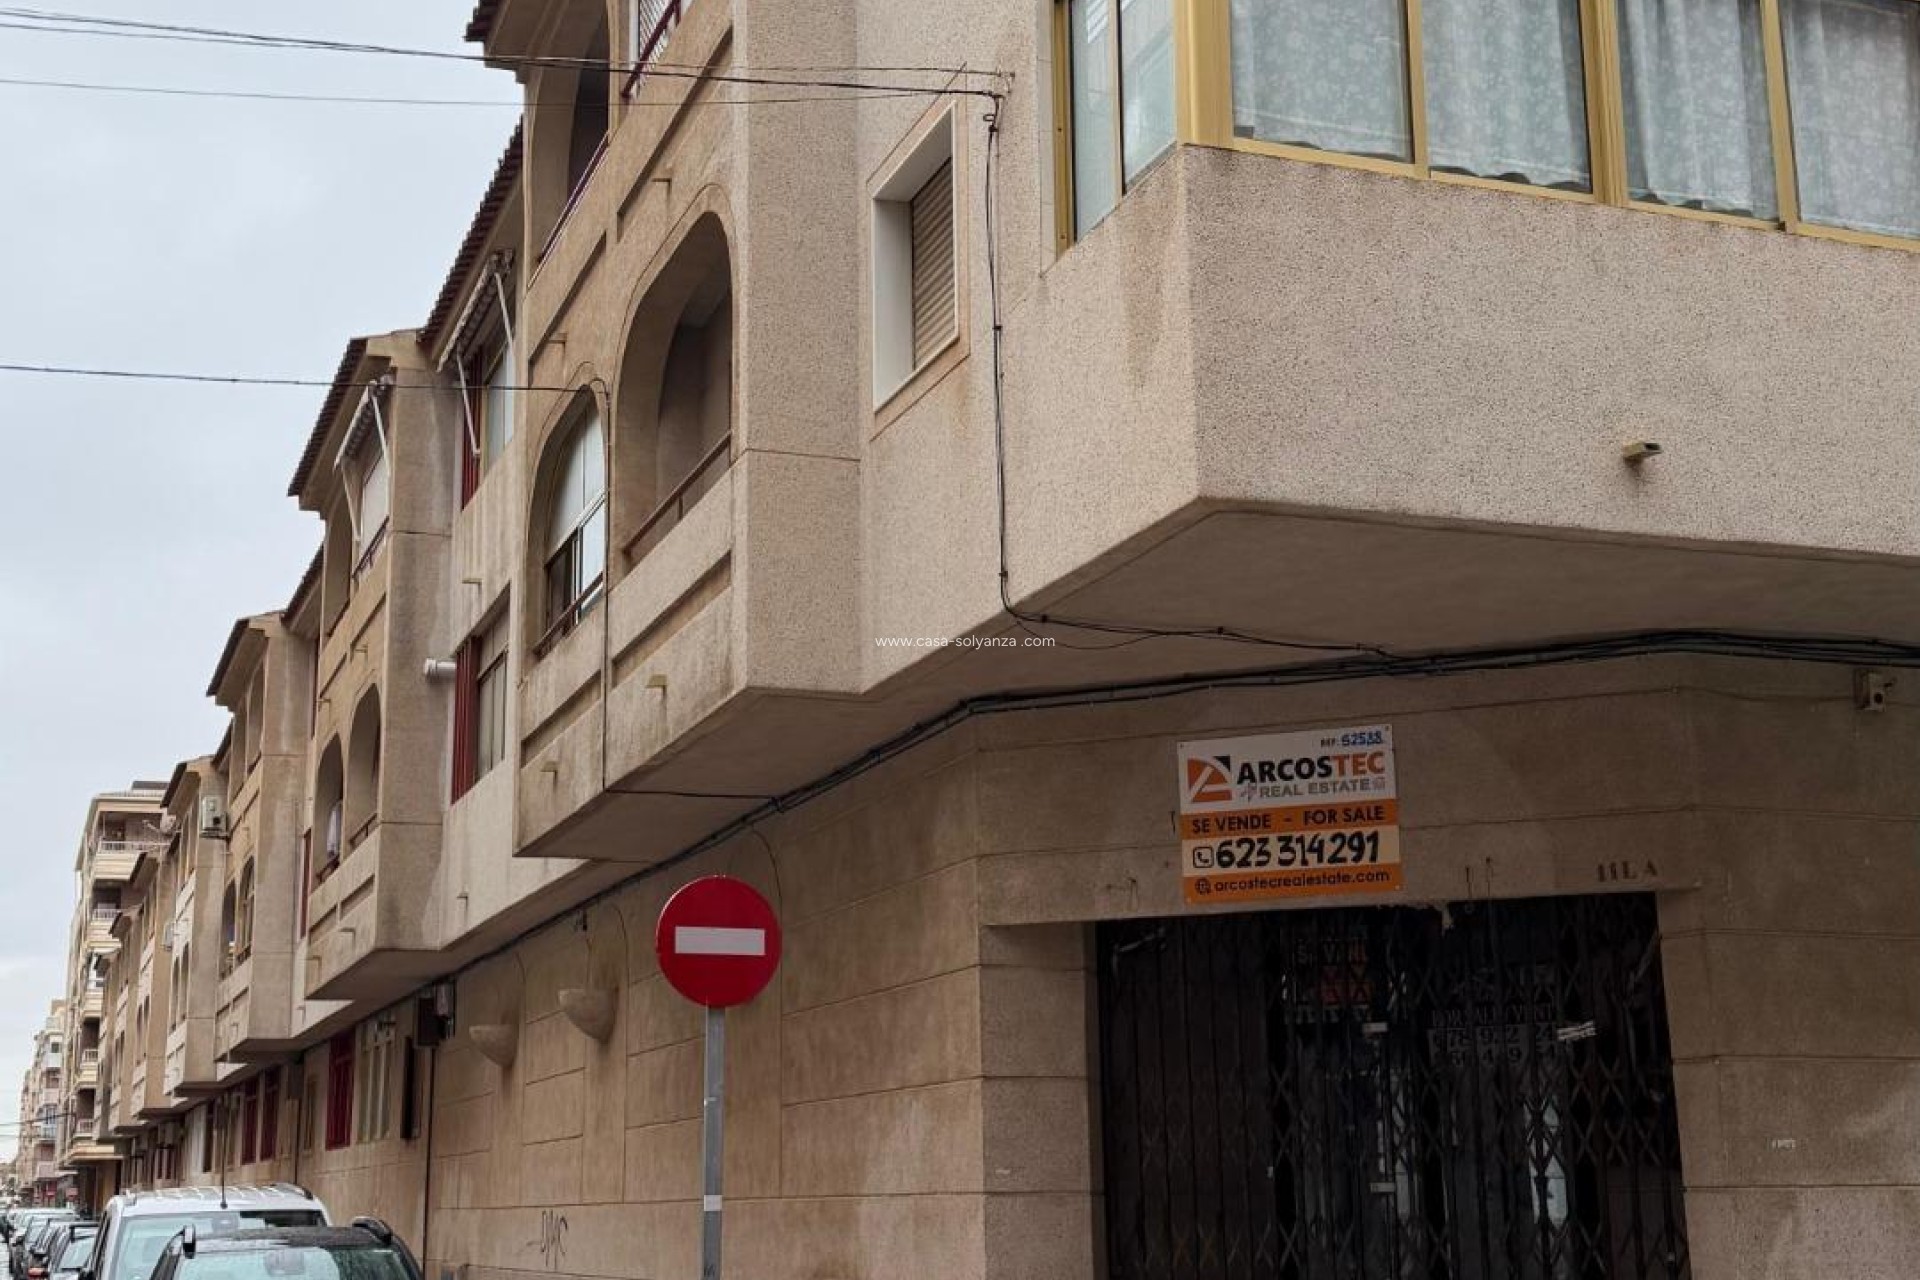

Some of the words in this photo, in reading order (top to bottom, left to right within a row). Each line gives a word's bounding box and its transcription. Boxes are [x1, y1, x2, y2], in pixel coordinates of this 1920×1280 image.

[1237, 751, 1385, 785] ARCOSTEC
[1259, 783, 1303, 798] REAL
[1307, 778, 1370, 795] ESTATE
[1192, 818, 1210, 834] SE
[1215, 814, 1272, 832] VENDE
[1302, 810, 1338, 825] FOR
[1343, 805, 1385, 823] SALE
[1214, 868, 1390, 893] arcostecrealestate.com
